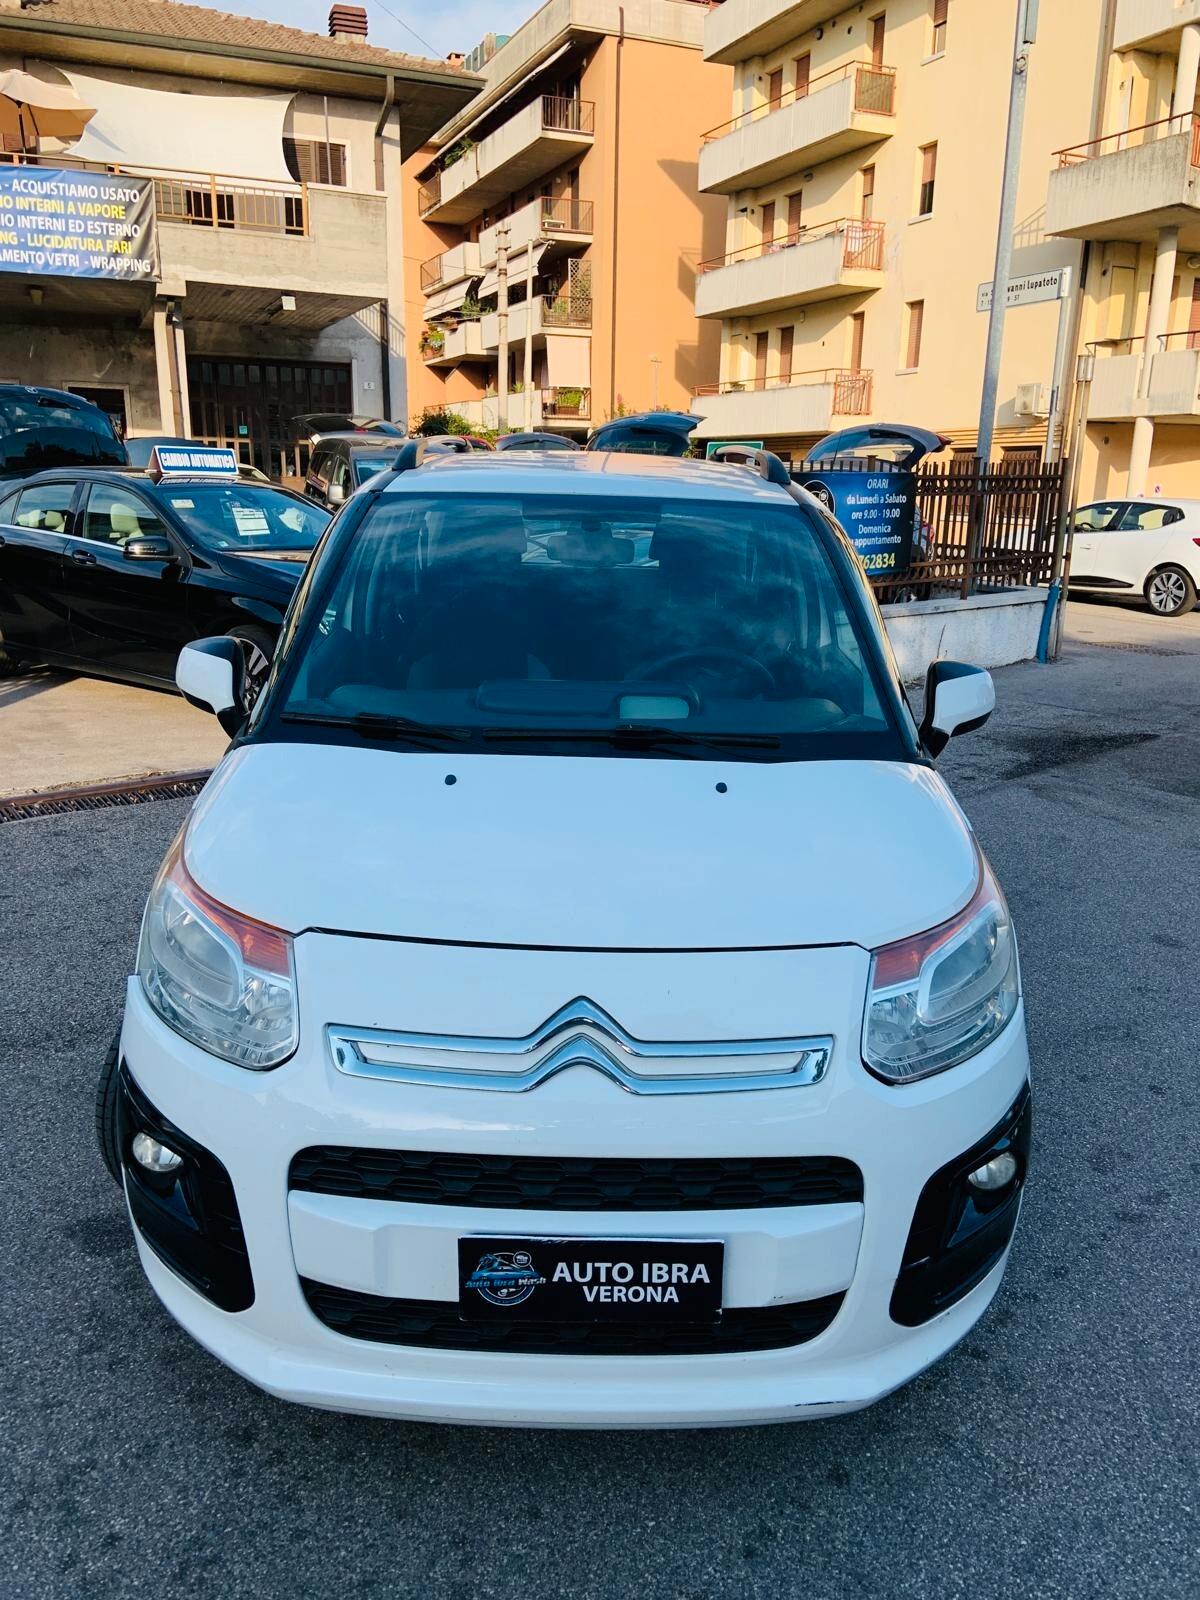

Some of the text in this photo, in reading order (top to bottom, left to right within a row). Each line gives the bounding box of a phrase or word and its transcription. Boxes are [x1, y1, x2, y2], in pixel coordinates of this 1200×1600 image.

[12, 179, 98, 197] ACQUISTIAMO
[100, 187, 140, 203] USATO
[0, 195, 126, 220] IO INTERNI A VAPORE
[0, 213, 141, 238] IO INTERNI ED ESTERNO
[0, 231, 18, 245] NG
[27, 233, 104, 252] LUCIDATURA
[106, 240, 132, 255] FARI
[46, 252, 80, 268] VETRI
[90, 256, 151, 272] WRAPPING
[1007, 281, 1026, 293] vanni
[160, 452, 235, 469] CAMBIO AUTOMATICO
[867, 478, 889, 489] ORARI
[846, 494, 857, 505] da
[879, 496, 885, 504] a
[885, 493, 907, 504] Sabato
[851, 511, 863, 520] ore
[863, 509, 878, 520] 9.00
[882, 508, 901, 518] 19.00
[858, 523, 892, 534] Domenica
[854, 534, 902, 548] appuntamento
[858, 552, 896, 570] 762834
[552, 1262, 711, 1284] AUTO IBRA
[582, 1286, 680, 1303] VERONA
